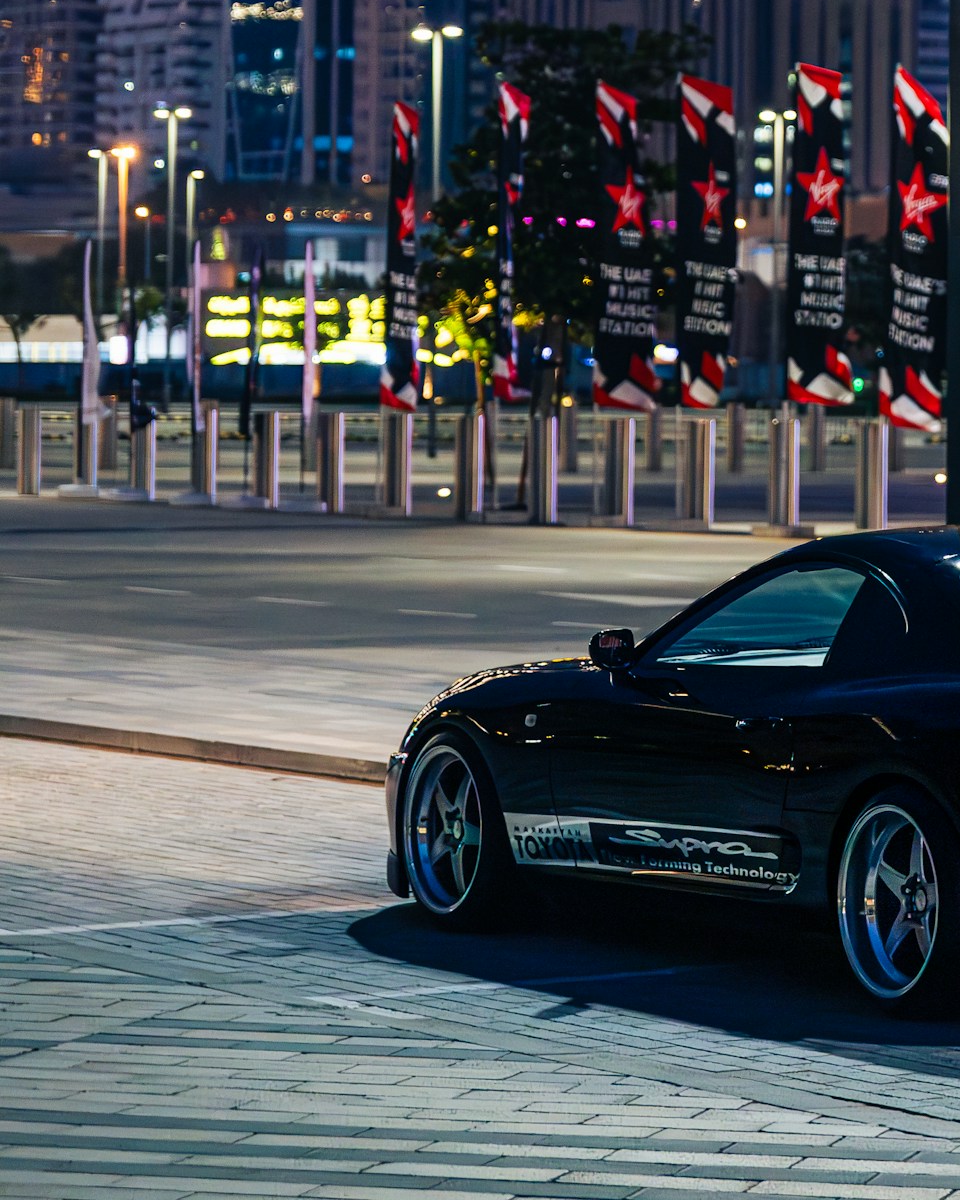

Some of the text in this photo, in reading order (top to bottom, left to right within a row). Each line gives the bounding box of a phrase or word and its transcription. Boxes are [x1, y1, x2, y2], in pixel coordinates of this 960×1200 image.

[624, 267, 652, 284] UAE
[514, 834, 594, 862] TOYOTA
[608, 829, 779, 860] Supra
[705, 861, 800, 891] Technology
